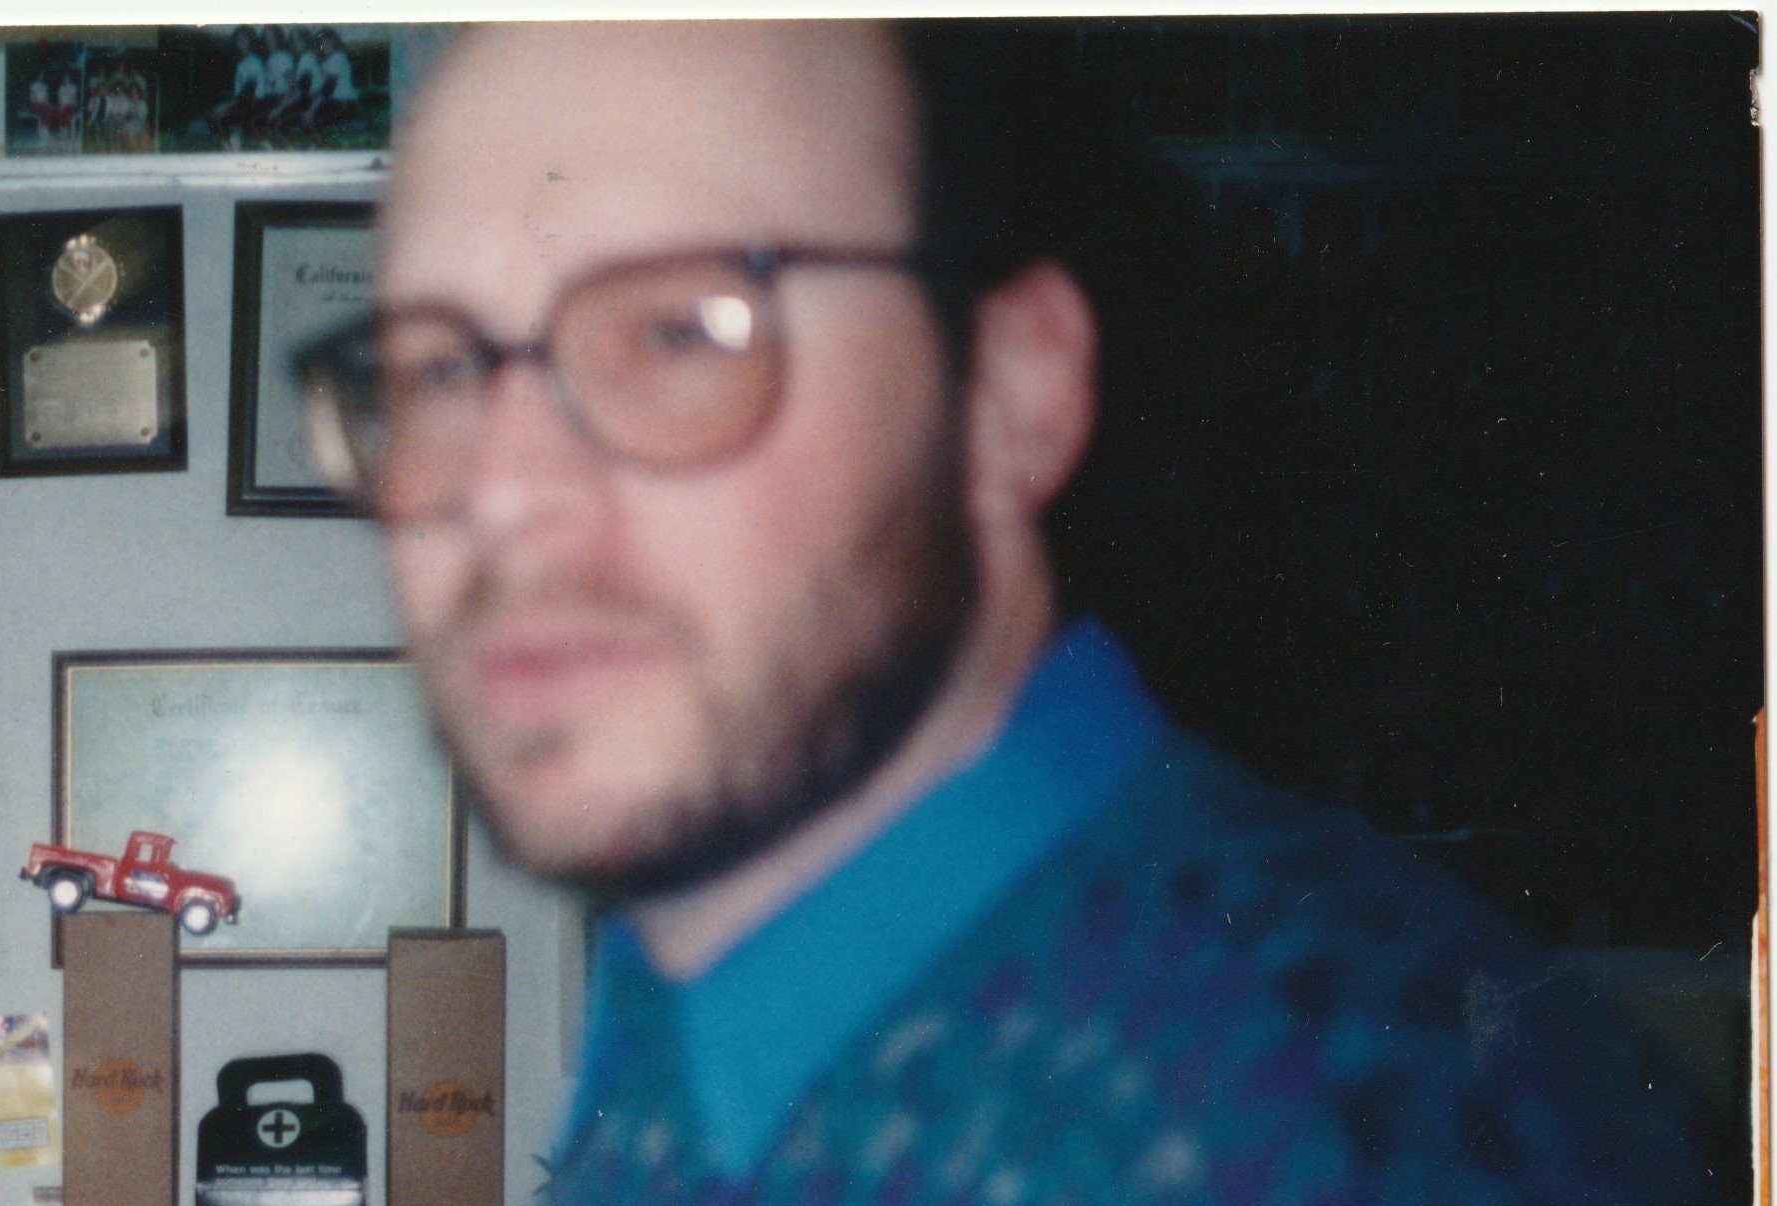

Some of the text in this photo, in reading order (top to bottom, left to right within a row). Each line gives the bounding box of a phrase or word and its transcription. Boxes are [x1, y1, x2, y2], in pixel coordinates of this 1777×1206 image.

[71, 1067, 164, 1093] Hard Rock
[398, 1090, 497, 1117] Hard Rock
[215, 1164, 246, 1175] When
[274, 1164, 292, 1175] the
